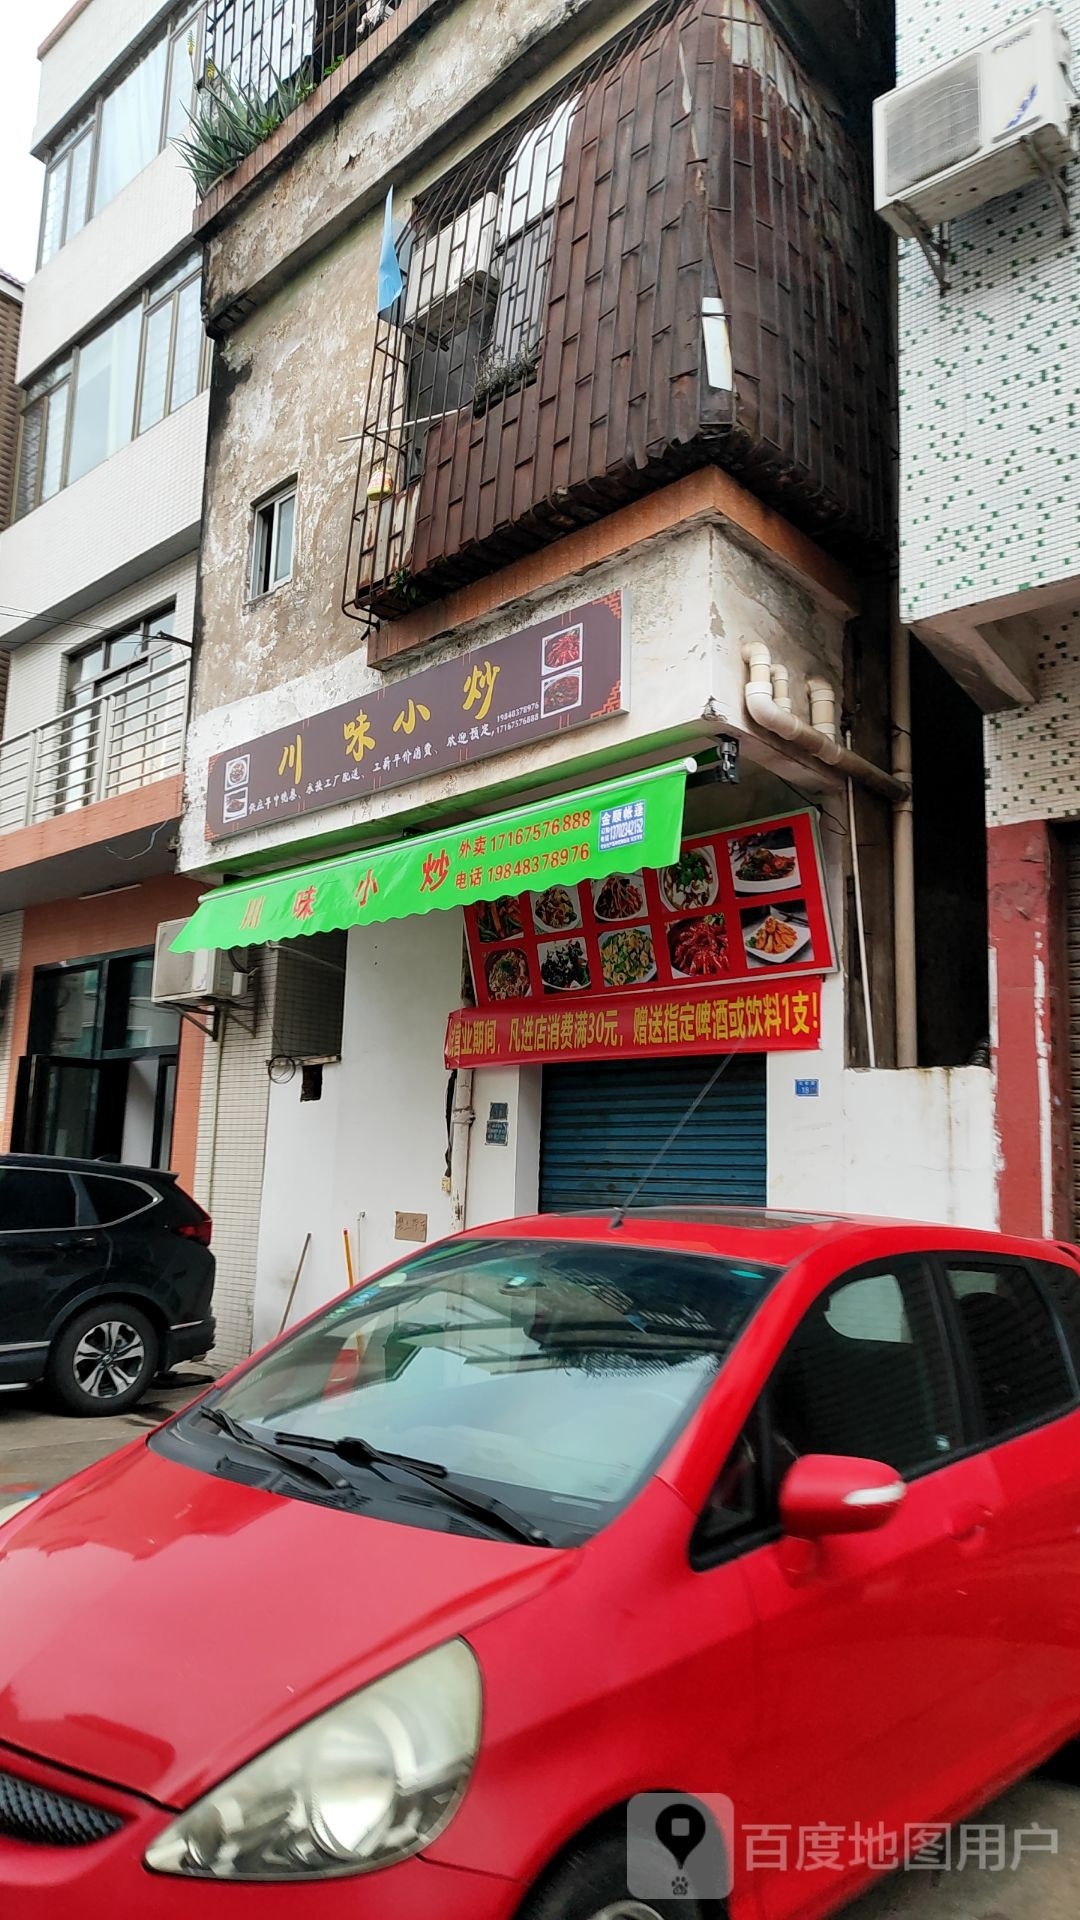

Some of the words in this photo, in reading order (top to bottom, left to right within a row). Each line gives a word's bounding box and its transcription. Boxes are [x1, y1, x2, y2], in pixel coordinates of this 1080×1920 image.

[277, 660, 500, 785] 川味小炒
[455, 865, 483, 890] 电话
[487, 842, 590, 883] 19848378976
[459, 834, 487, 858] 外卖
[490, 809, 592, 852] 17167576888
[239, 848, 450, 930] 川味小炒
